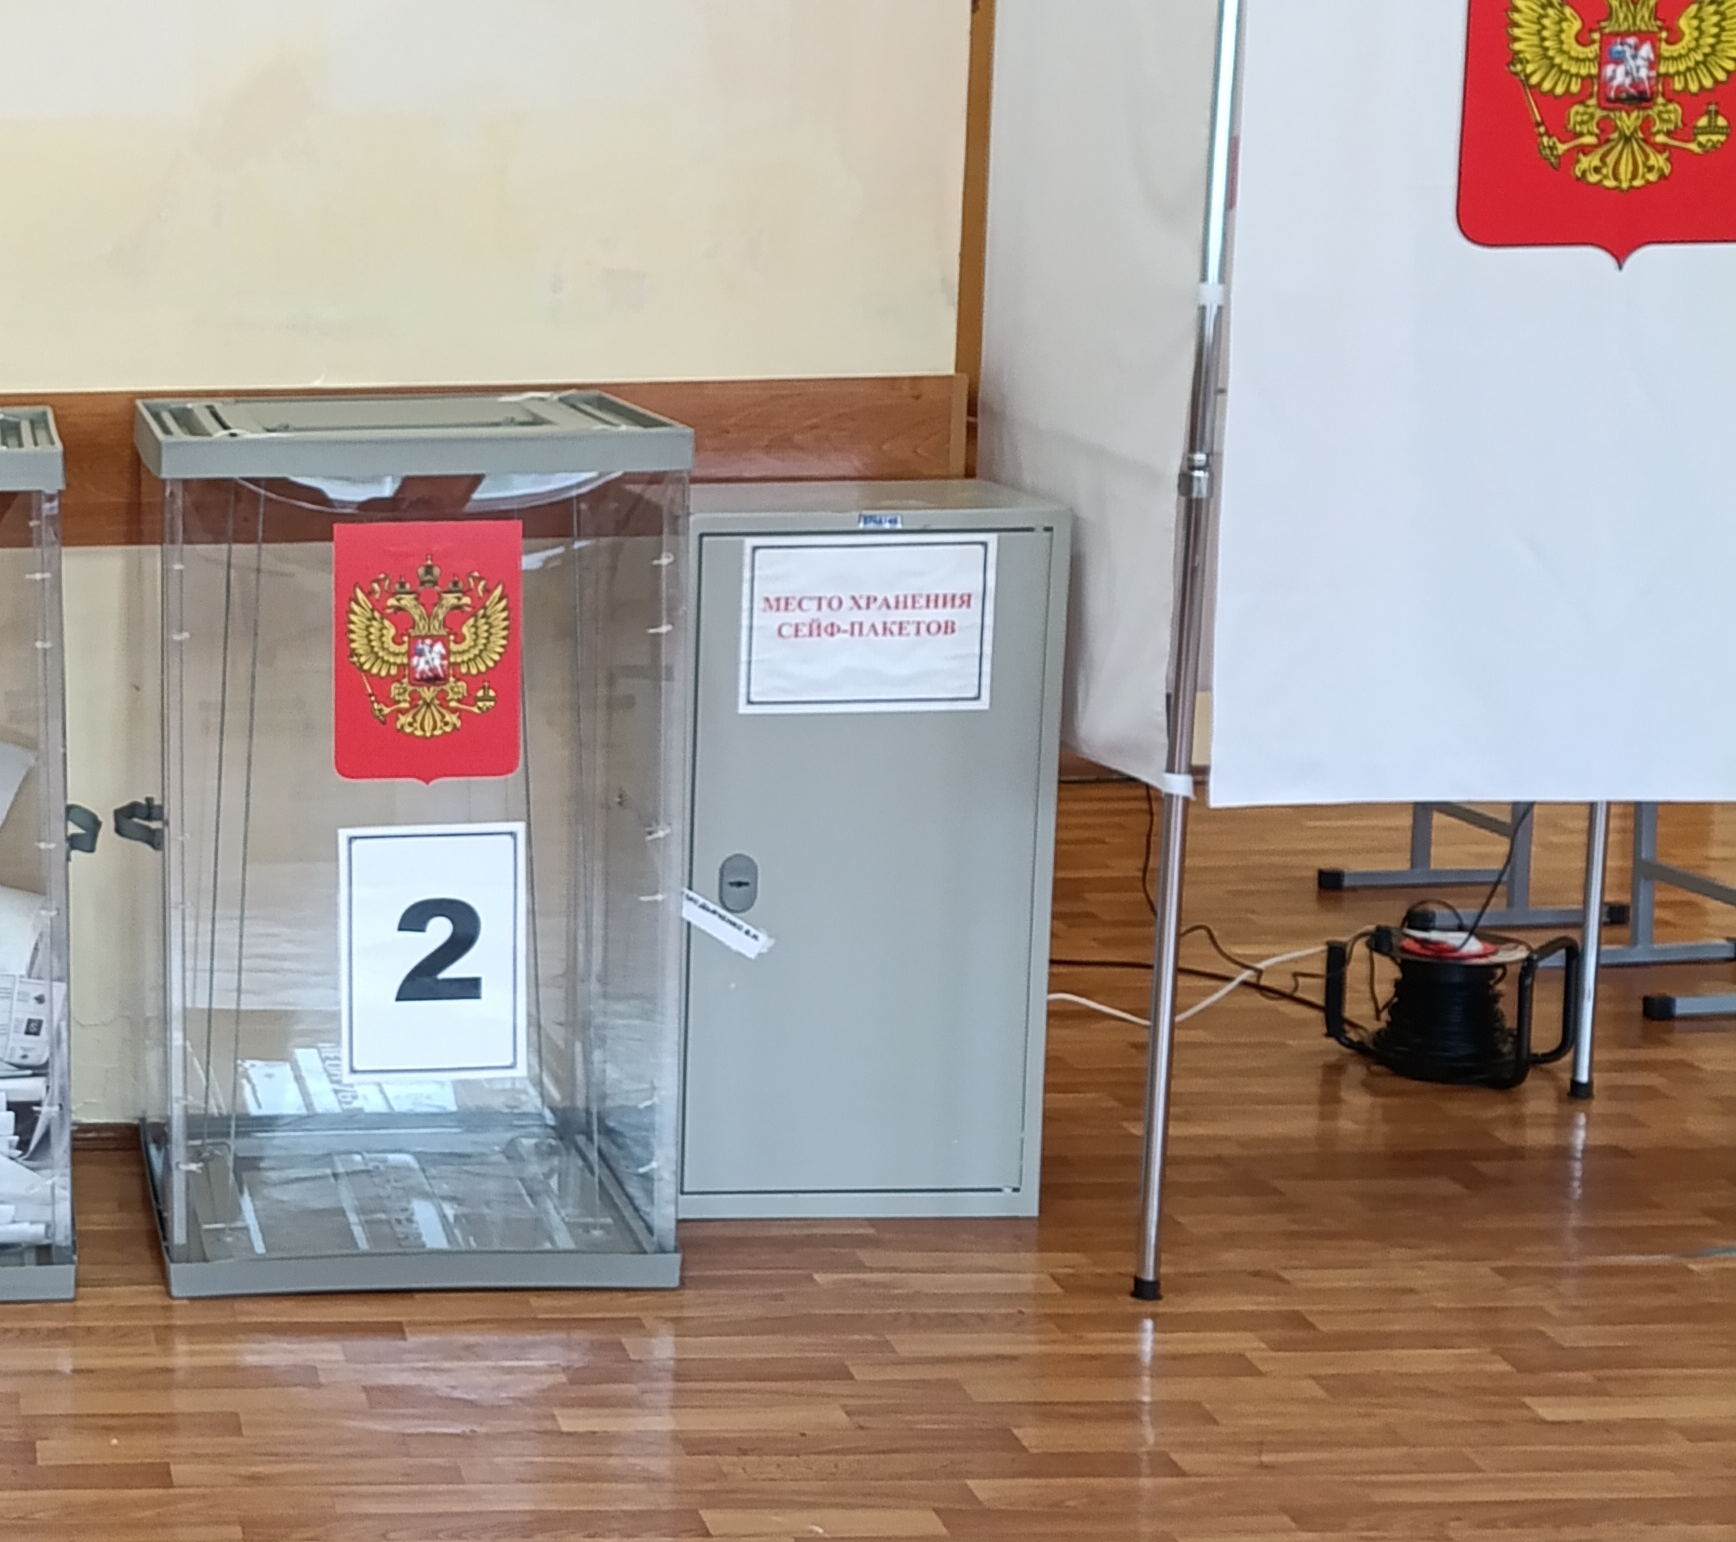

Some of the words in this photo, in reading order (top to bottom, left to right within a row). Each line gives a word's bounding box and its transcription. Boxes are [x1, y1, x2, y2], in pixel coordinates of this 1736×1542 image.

[762, 595, 844, 613] МЕСТО
[848, 592, 973, 611] ХРАНЕНИЯ
[776, 618, 957, 640] СЕЙФ-ПАКЕТОВ
[395, 897, 482, 1002] 2
